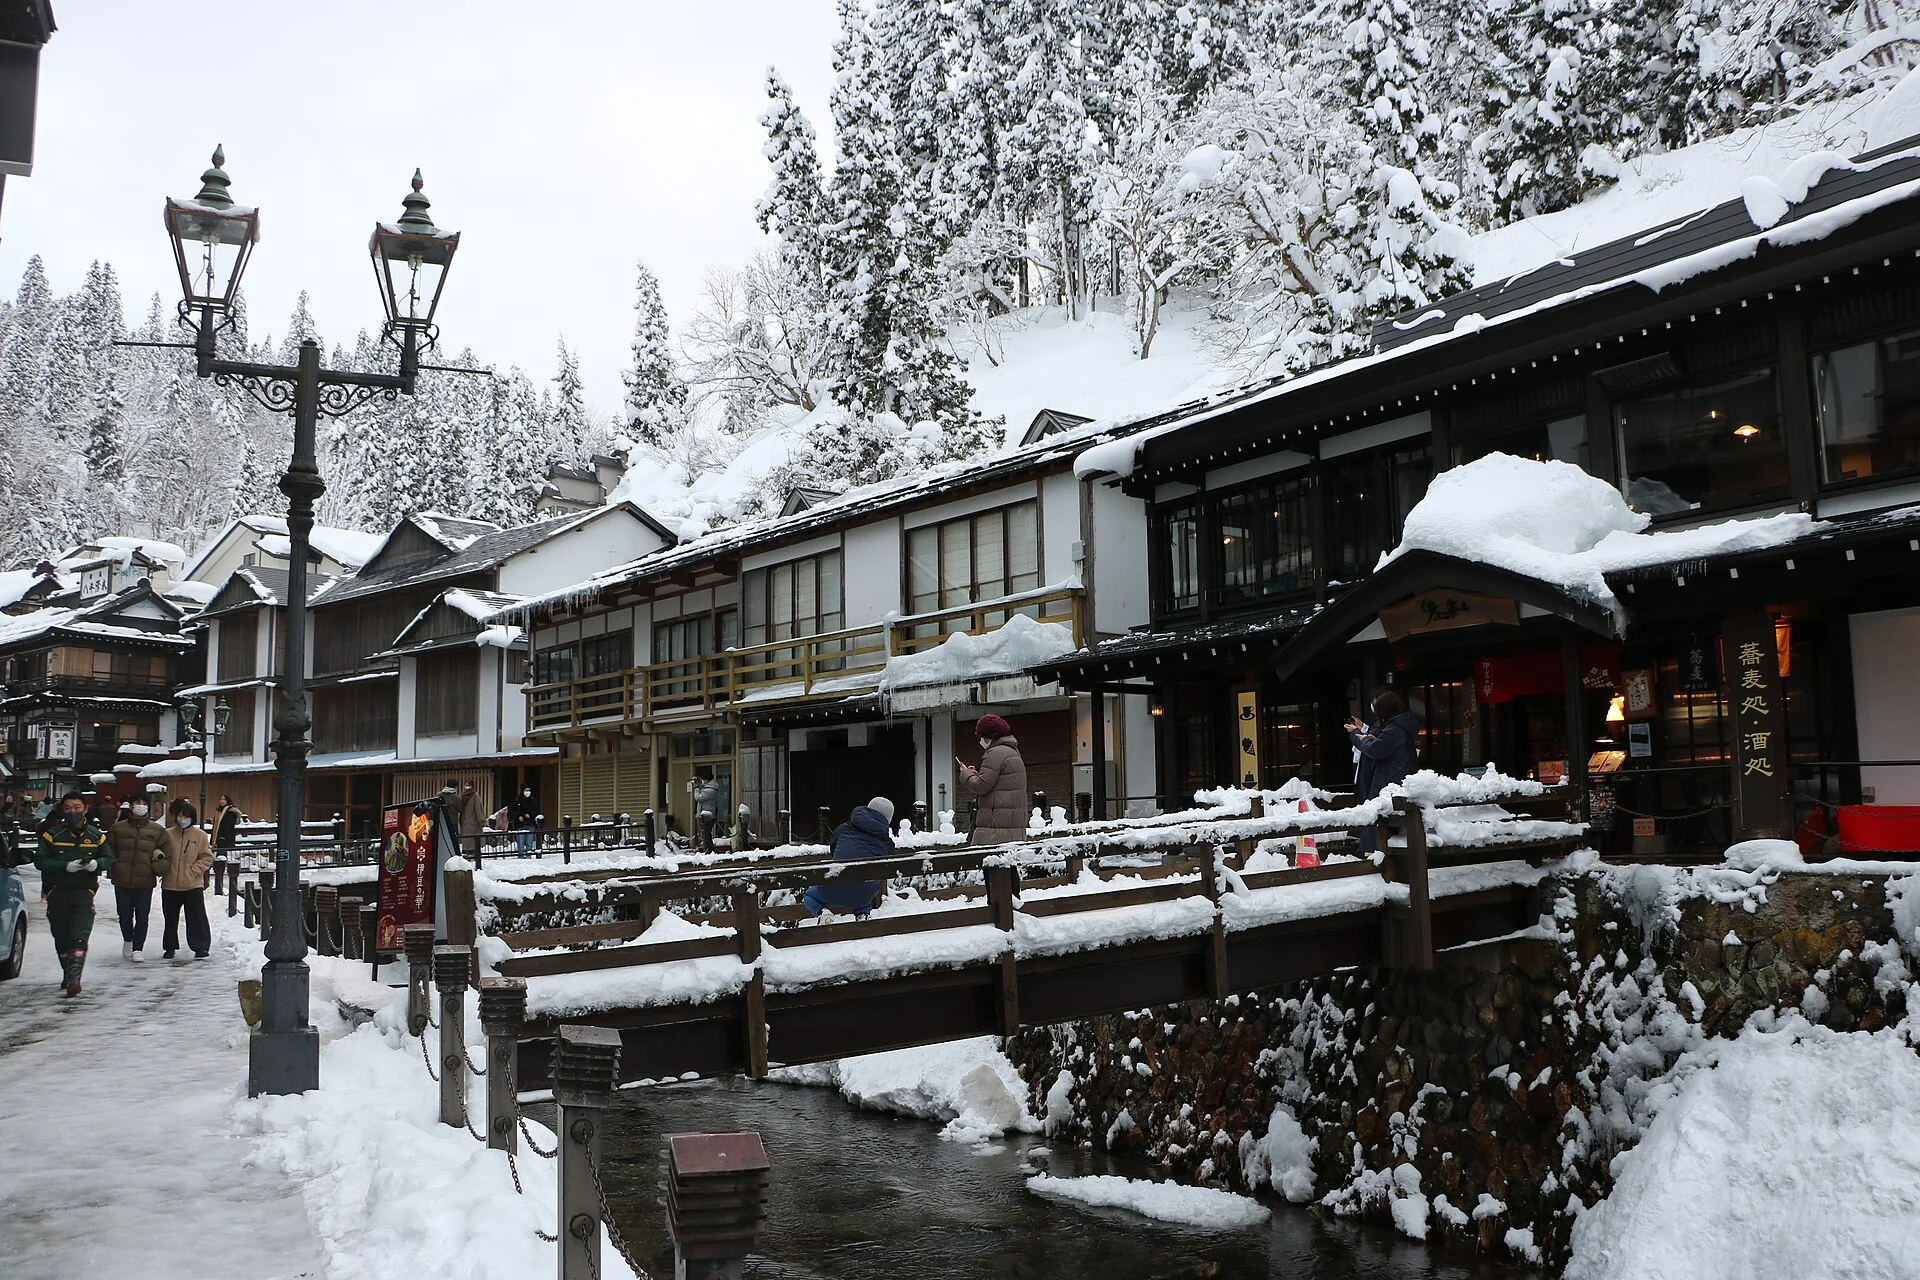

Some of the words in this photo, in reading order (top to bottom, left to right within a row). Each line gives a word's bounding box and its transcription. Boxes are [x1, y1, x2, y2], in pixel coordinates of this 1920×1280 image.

[1689, 648, 1704, 681] 蕎麦
[1738, 641, 1774, 777] 蕎麦処・酒処
[415, 863, 425, 910] 伊豆の華
